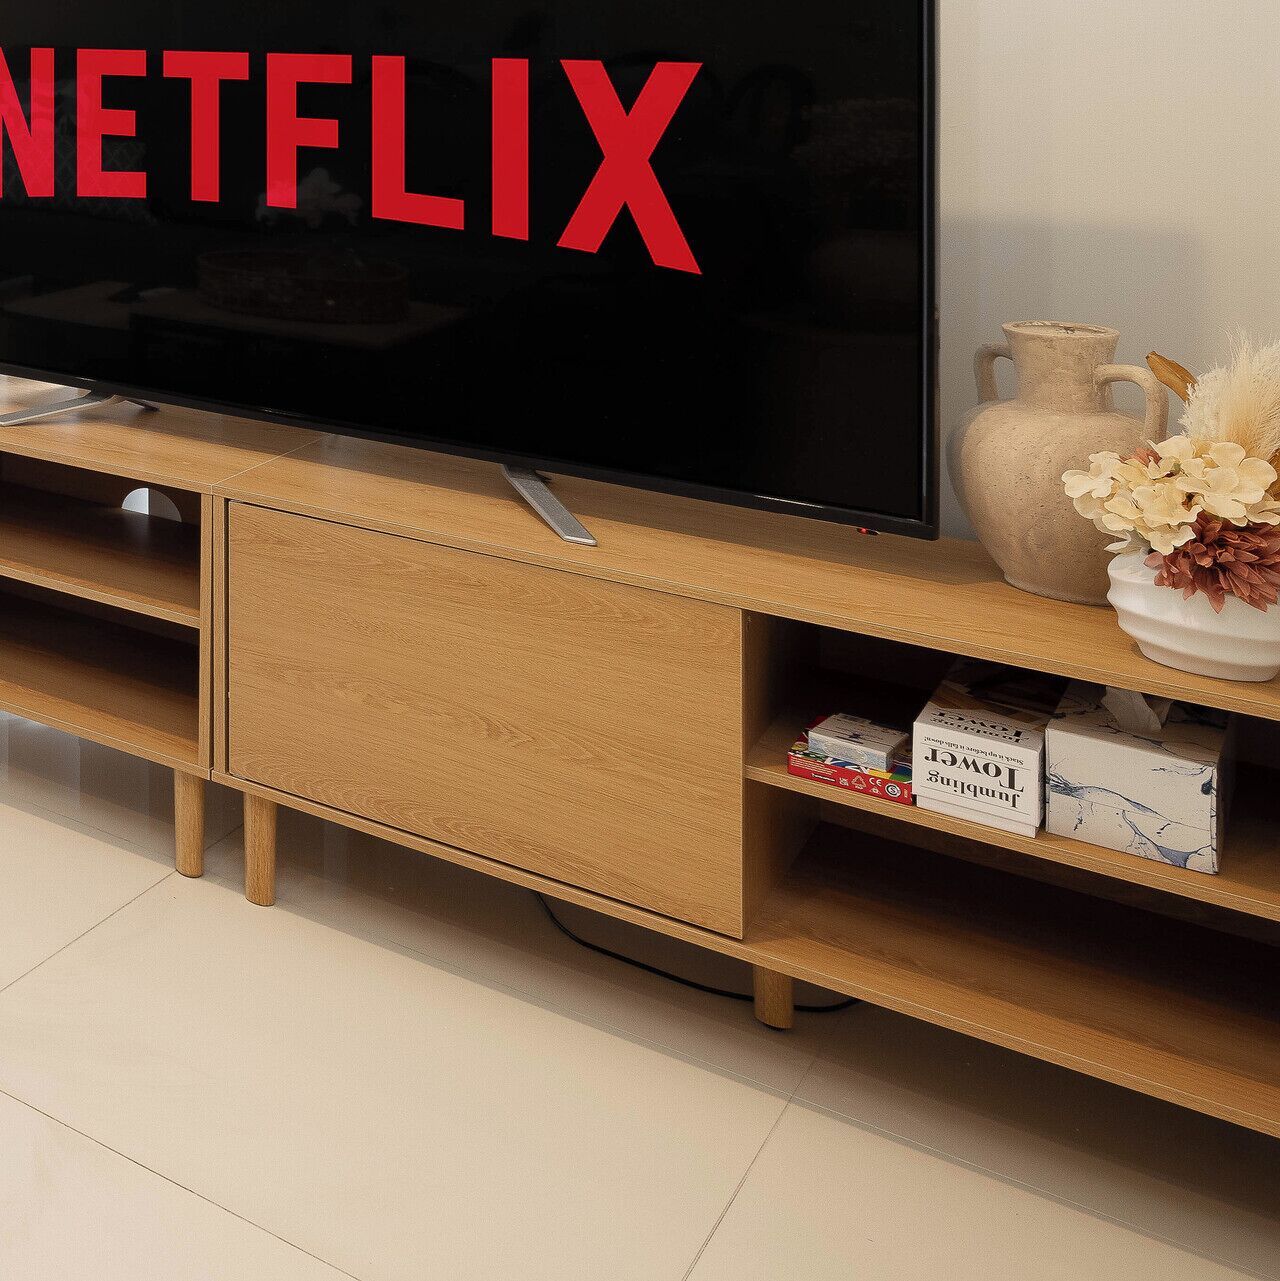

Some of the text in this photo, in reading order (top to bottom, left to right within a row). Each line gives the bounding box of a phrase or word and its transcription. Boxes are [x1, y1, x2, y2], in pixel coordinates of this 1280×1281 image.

[944, 741, 959, 749] falls
[966, 746, 988, 757] before
[1004, 755, 1024, 766] Stack
[924, 747, 1025, 793] Tower
[926, 769, 1021, 809] Jumbling
